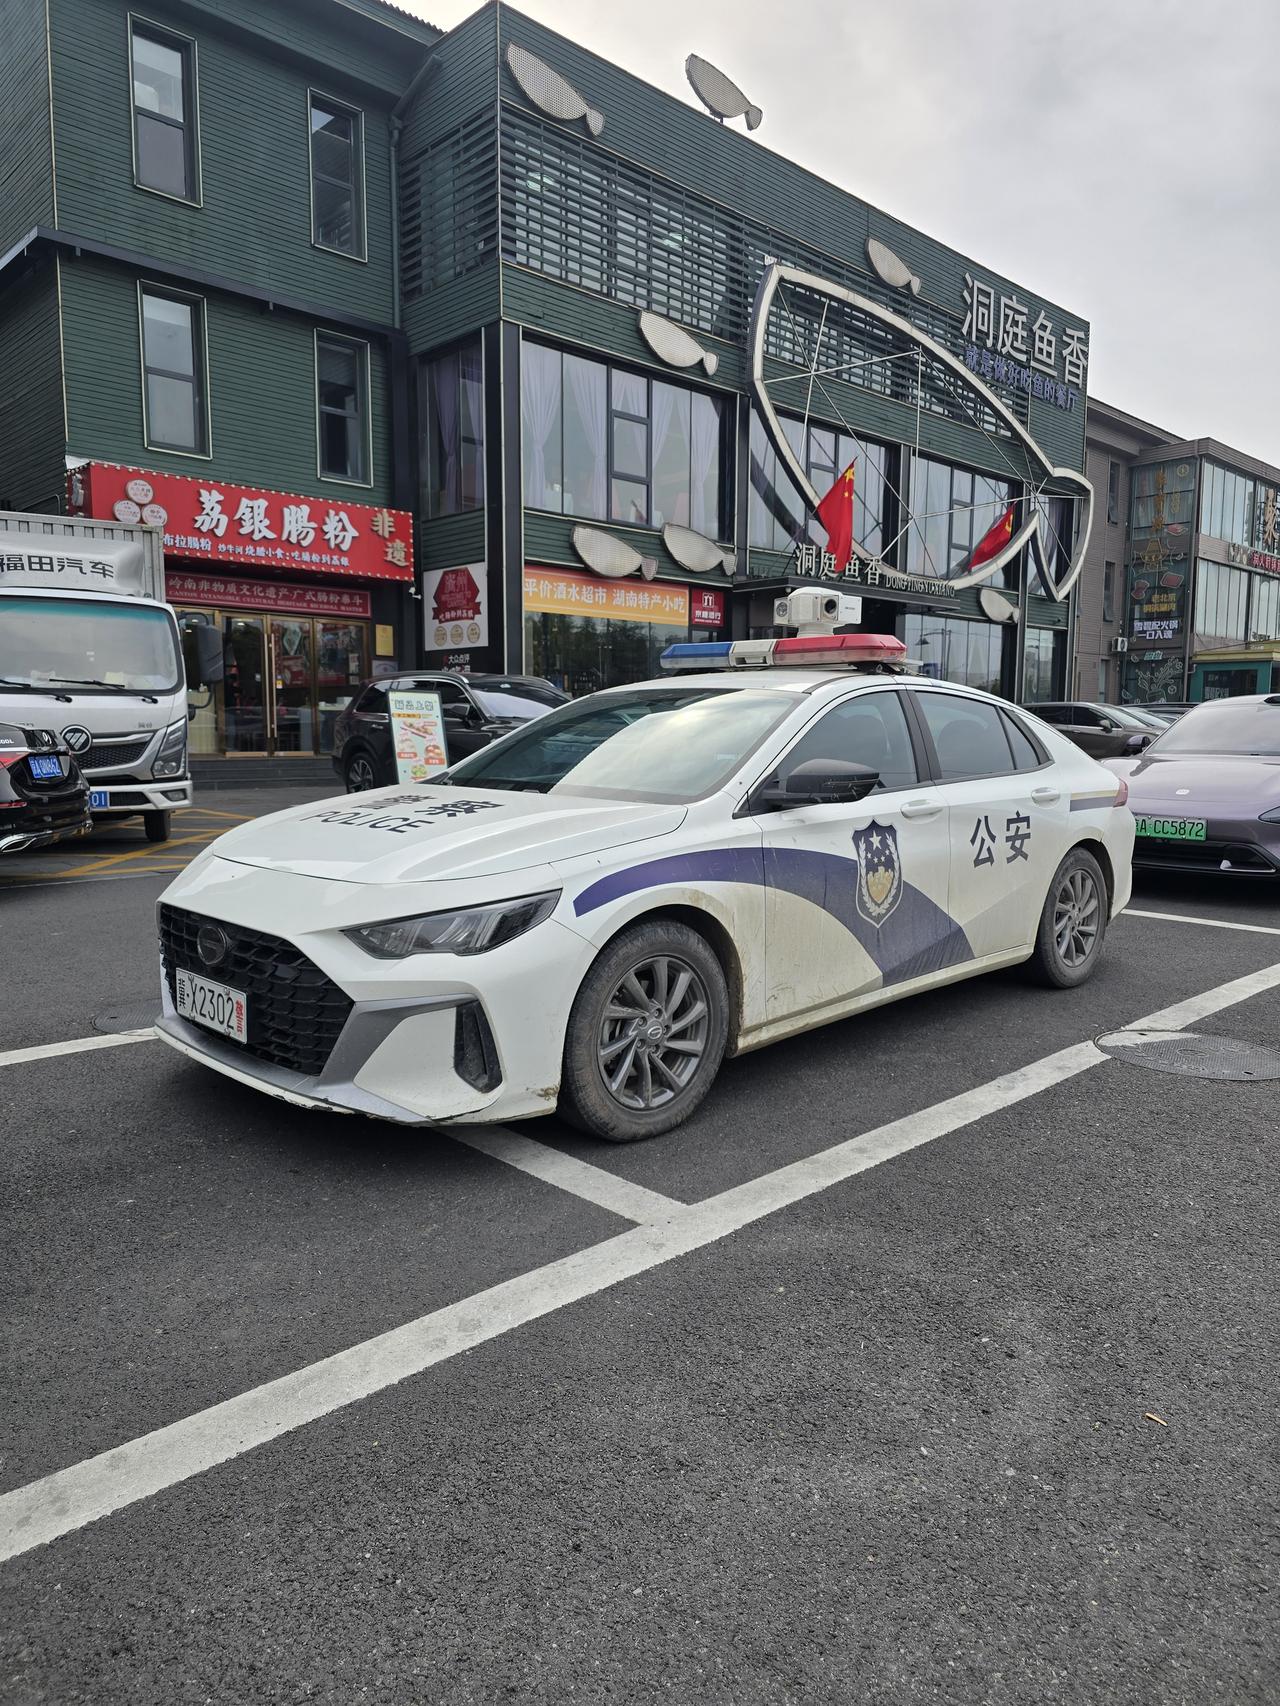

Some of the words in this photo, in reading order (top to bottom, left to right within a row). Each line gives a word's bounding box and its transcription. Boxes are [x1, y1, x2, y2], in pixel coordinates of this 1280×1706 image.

[961, 272, 1089, 389] 洞庭鱼香
[964, 342, 1080, 411] 就是做好吃鱼的餐厅
[194, 489, 360, 551] 荔銀腸粉
[0, 554, 114, 578] 福田汽车
[794, 542, 882, 586] 洞庭鱼香
[524, 578, 607, 604] 平价酒水超市
[612, 588, 686, 614] 湖南特产小吃
[1137, 630, 1173, 640] 一口入魂
[299, 811, 435, 834] POLICE
[970, 810, 1032, 868] 公安
